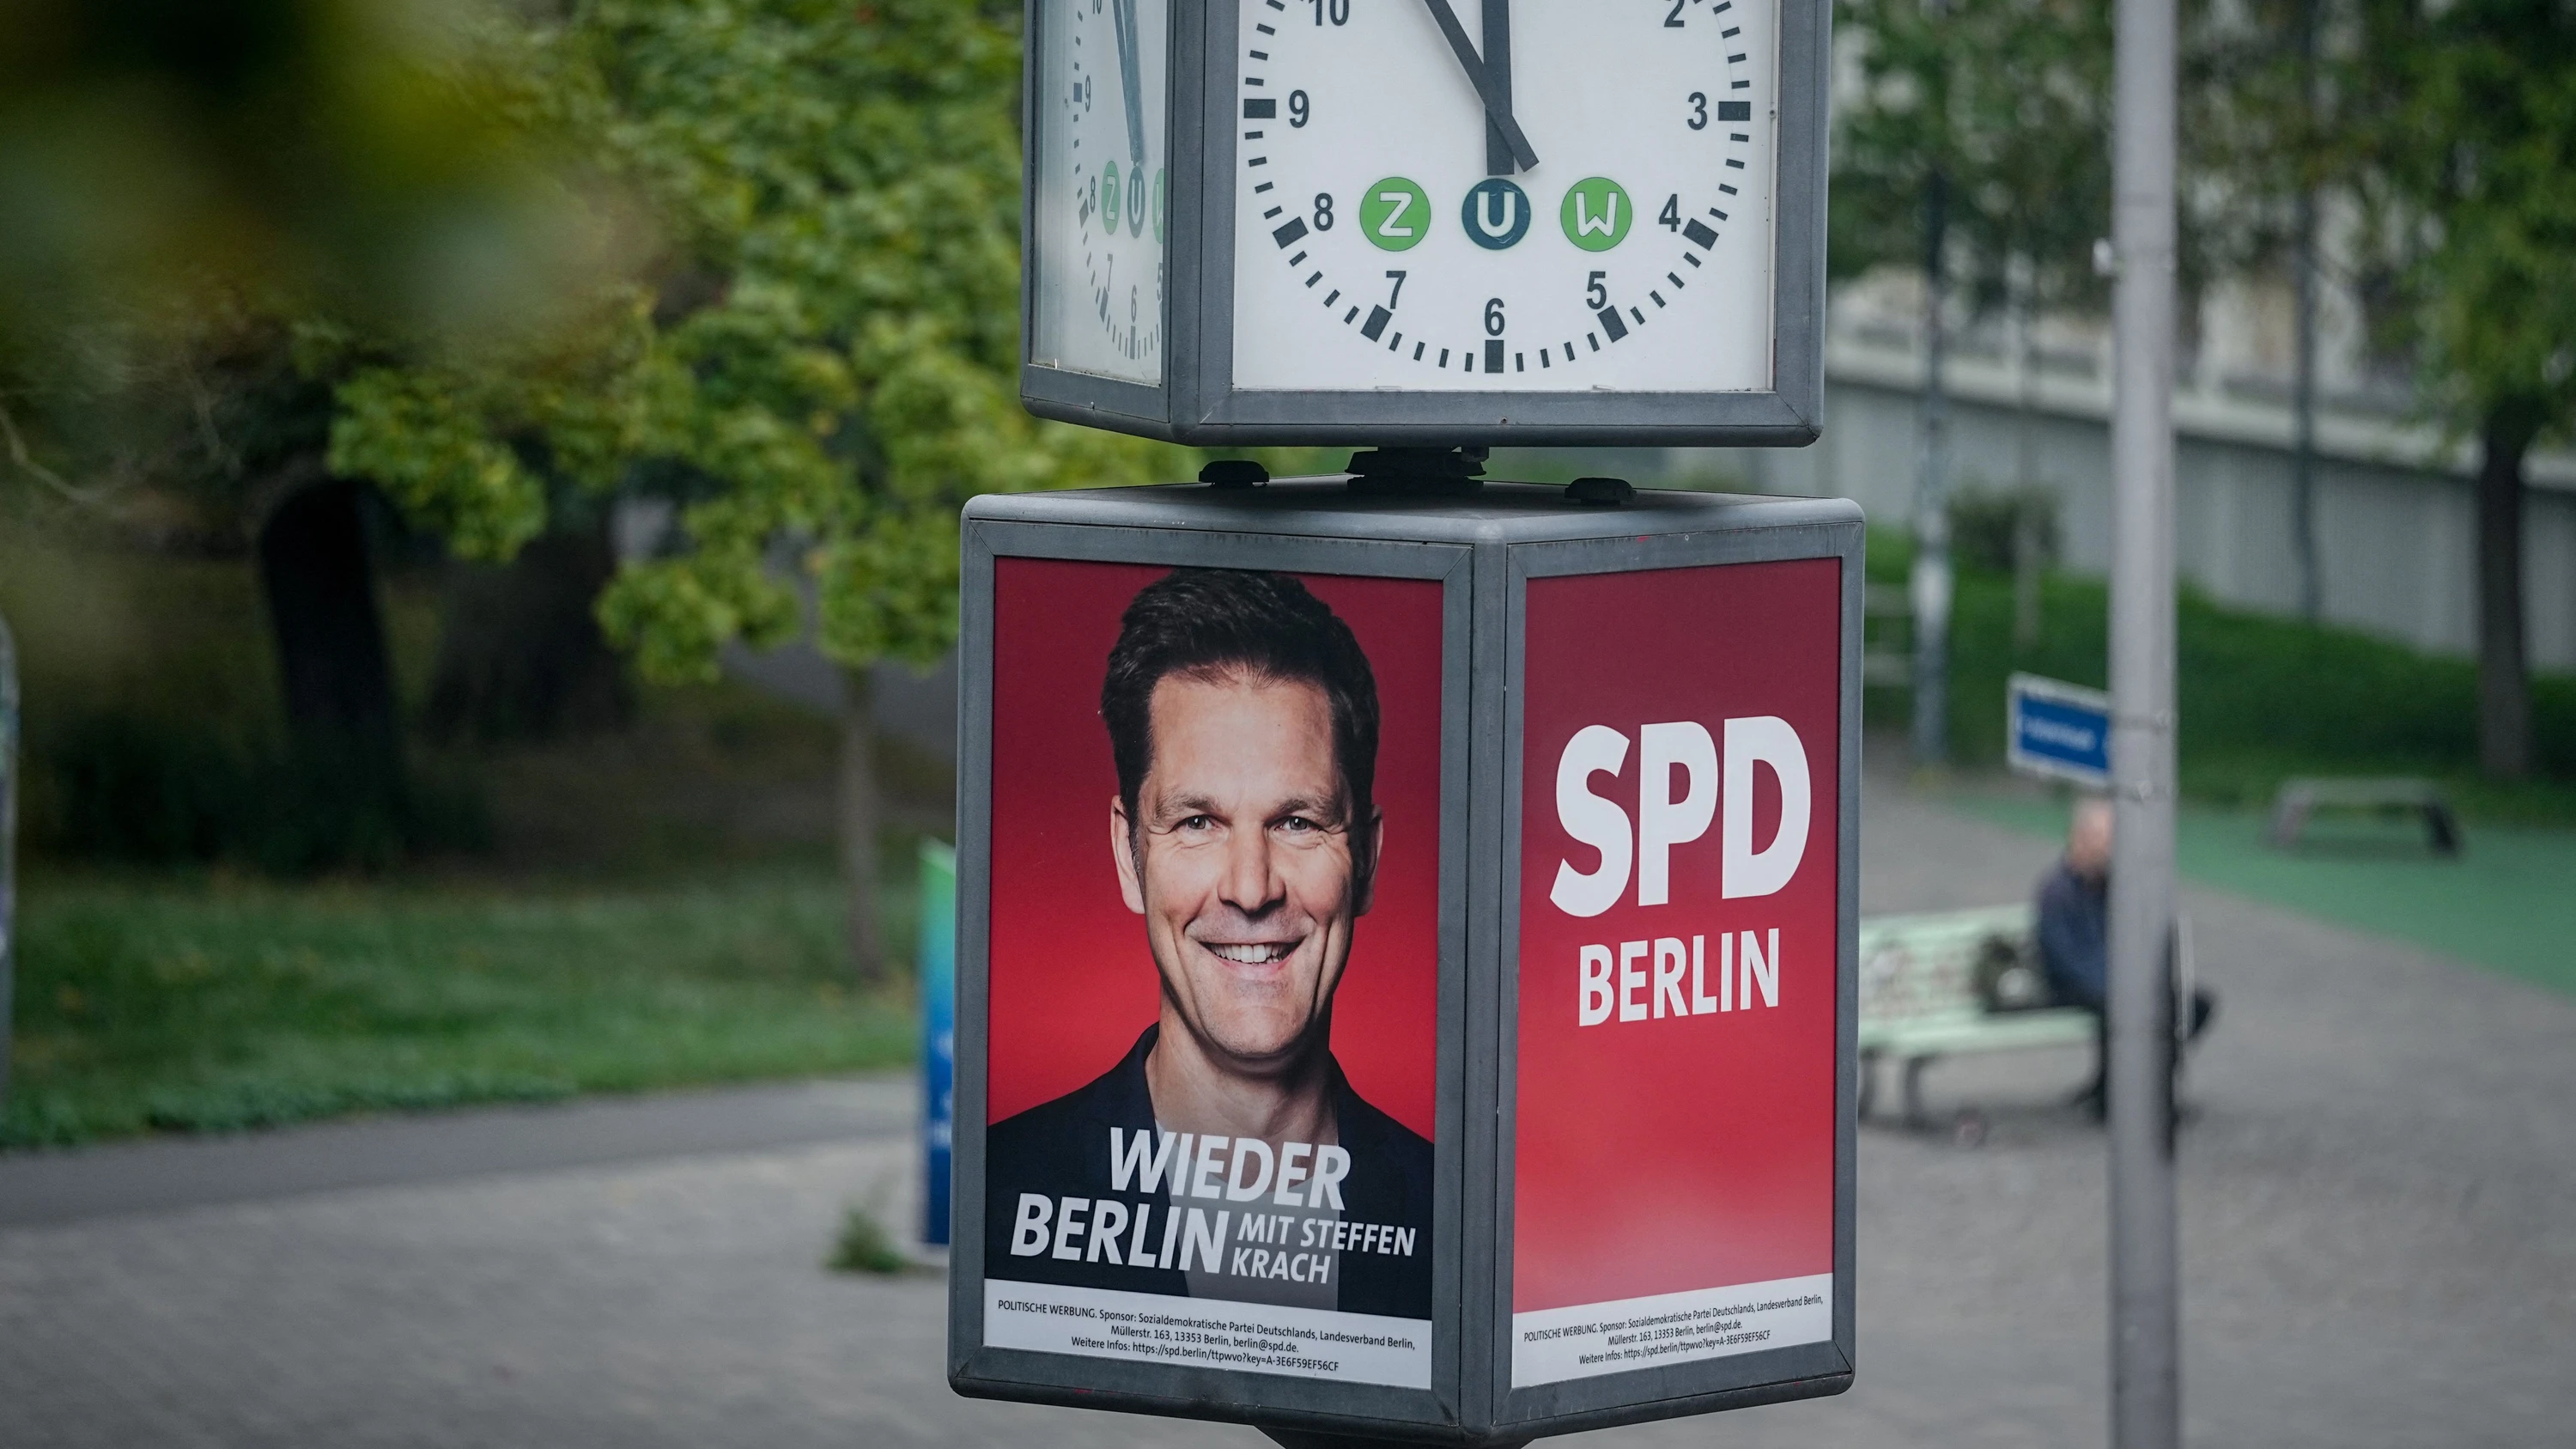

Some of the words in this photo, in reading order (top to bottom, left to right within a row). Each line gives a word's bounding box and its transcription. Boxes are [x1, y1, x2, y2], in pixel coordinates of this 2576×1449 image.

[1315, 0, 1349, 27] 10
[1084, 76, 1091, 112] 9
[1288, 89, 1309, 128] 9
[1686, 92, 1708, 130] 3
[1090, 175, 1096, 213] 8
[1105, 175, 1116, 222] Z
[1131, 178, 1142, 224] U
[1314, 193, 1334, 231] 8
[1658, 194, 1680, 231] 4
[1378, 192, 1413, 237] Z
[1477, 192, 1516, 238] U
[1575, 192, 1618, 237] W
[1107, 253, 1113, 291] 7
[1385, 271, 1406, 308] 7
[1587, 271, 1607, 309] 5
[1131, 284, 1137, 323] 6
[1485, 298, 1504, 336] 6
[1549, 715, 1811, 917] SPD
[1579, 928, 1779, 1026] BERLIN
[1110, 1126, 1351, 1210] WIEDER
[1010, 1192, 1230, 1274] BERLIN
[1237, 1212, 1287, 1245] MIT
[1301, 1217, 1416, 1257] STEFFEN
[1230, 1247, 1331, 1283] KRACH
[998, 1300, 1047, 1313] POLITISCHE
[1049, 1305, 1097, 1318] WERBUNG.
[1100, 1309, 1136, 1322] Sponsor:
[1139, 1313, 1227, 1330] Sozialdemokratische
[1230, 1321, 1255, 1334] Partei
[1257, 1324, 1317, 1341] Deutschlands,
[1320, 1330, 1385, 1346] Landesverband
[1388, 1336, 1415, 1350] Berlin,
[1524, 1328, 1561, 1342] POLITISCHE
[1563, 1324, 1598, 1336] WERBUNG.
[1600, 1321, 1627, 1334] Sponsor:
[1628, 1310, 1692, 1328] Sozialdemokratische
[1693, 1308, 1711, 1320] Partei
[1712, 1303, 1755, 1317] Deutschlands,
[1757, 1295, 1802, 1312] Landesverband
[1804, 1294, 1823, 1306] Berlin,
[1608, 1334, 1637, 1346] Müllerstr.
[1640, 1331, 1653, 1342] 163,
[1655, 1329, 1674, 1340] 13353
[1675, 1325, 1694, 1337] Berlin,
[1697, 1319, 1742, 1334] berlin@spd.de.
[1072, 1336, 1104, 1349] Weitere
[1107, 1340, 1130, 1351] Infos:
[1111, 1325, 1151, 1338] Müllerstr.
[1154, 1329, 1172, 1342] 163,
[1175, 1331, 1201, 1343] 13353
[1204, 1334, 1230, 1348] Berlin,
[1234, 1336, 1298, 1354] berlin@spd.de.
[1579, 1353, 1603, 1364] Weitere
[1605, 1350, 1623, 1361] Infos:
